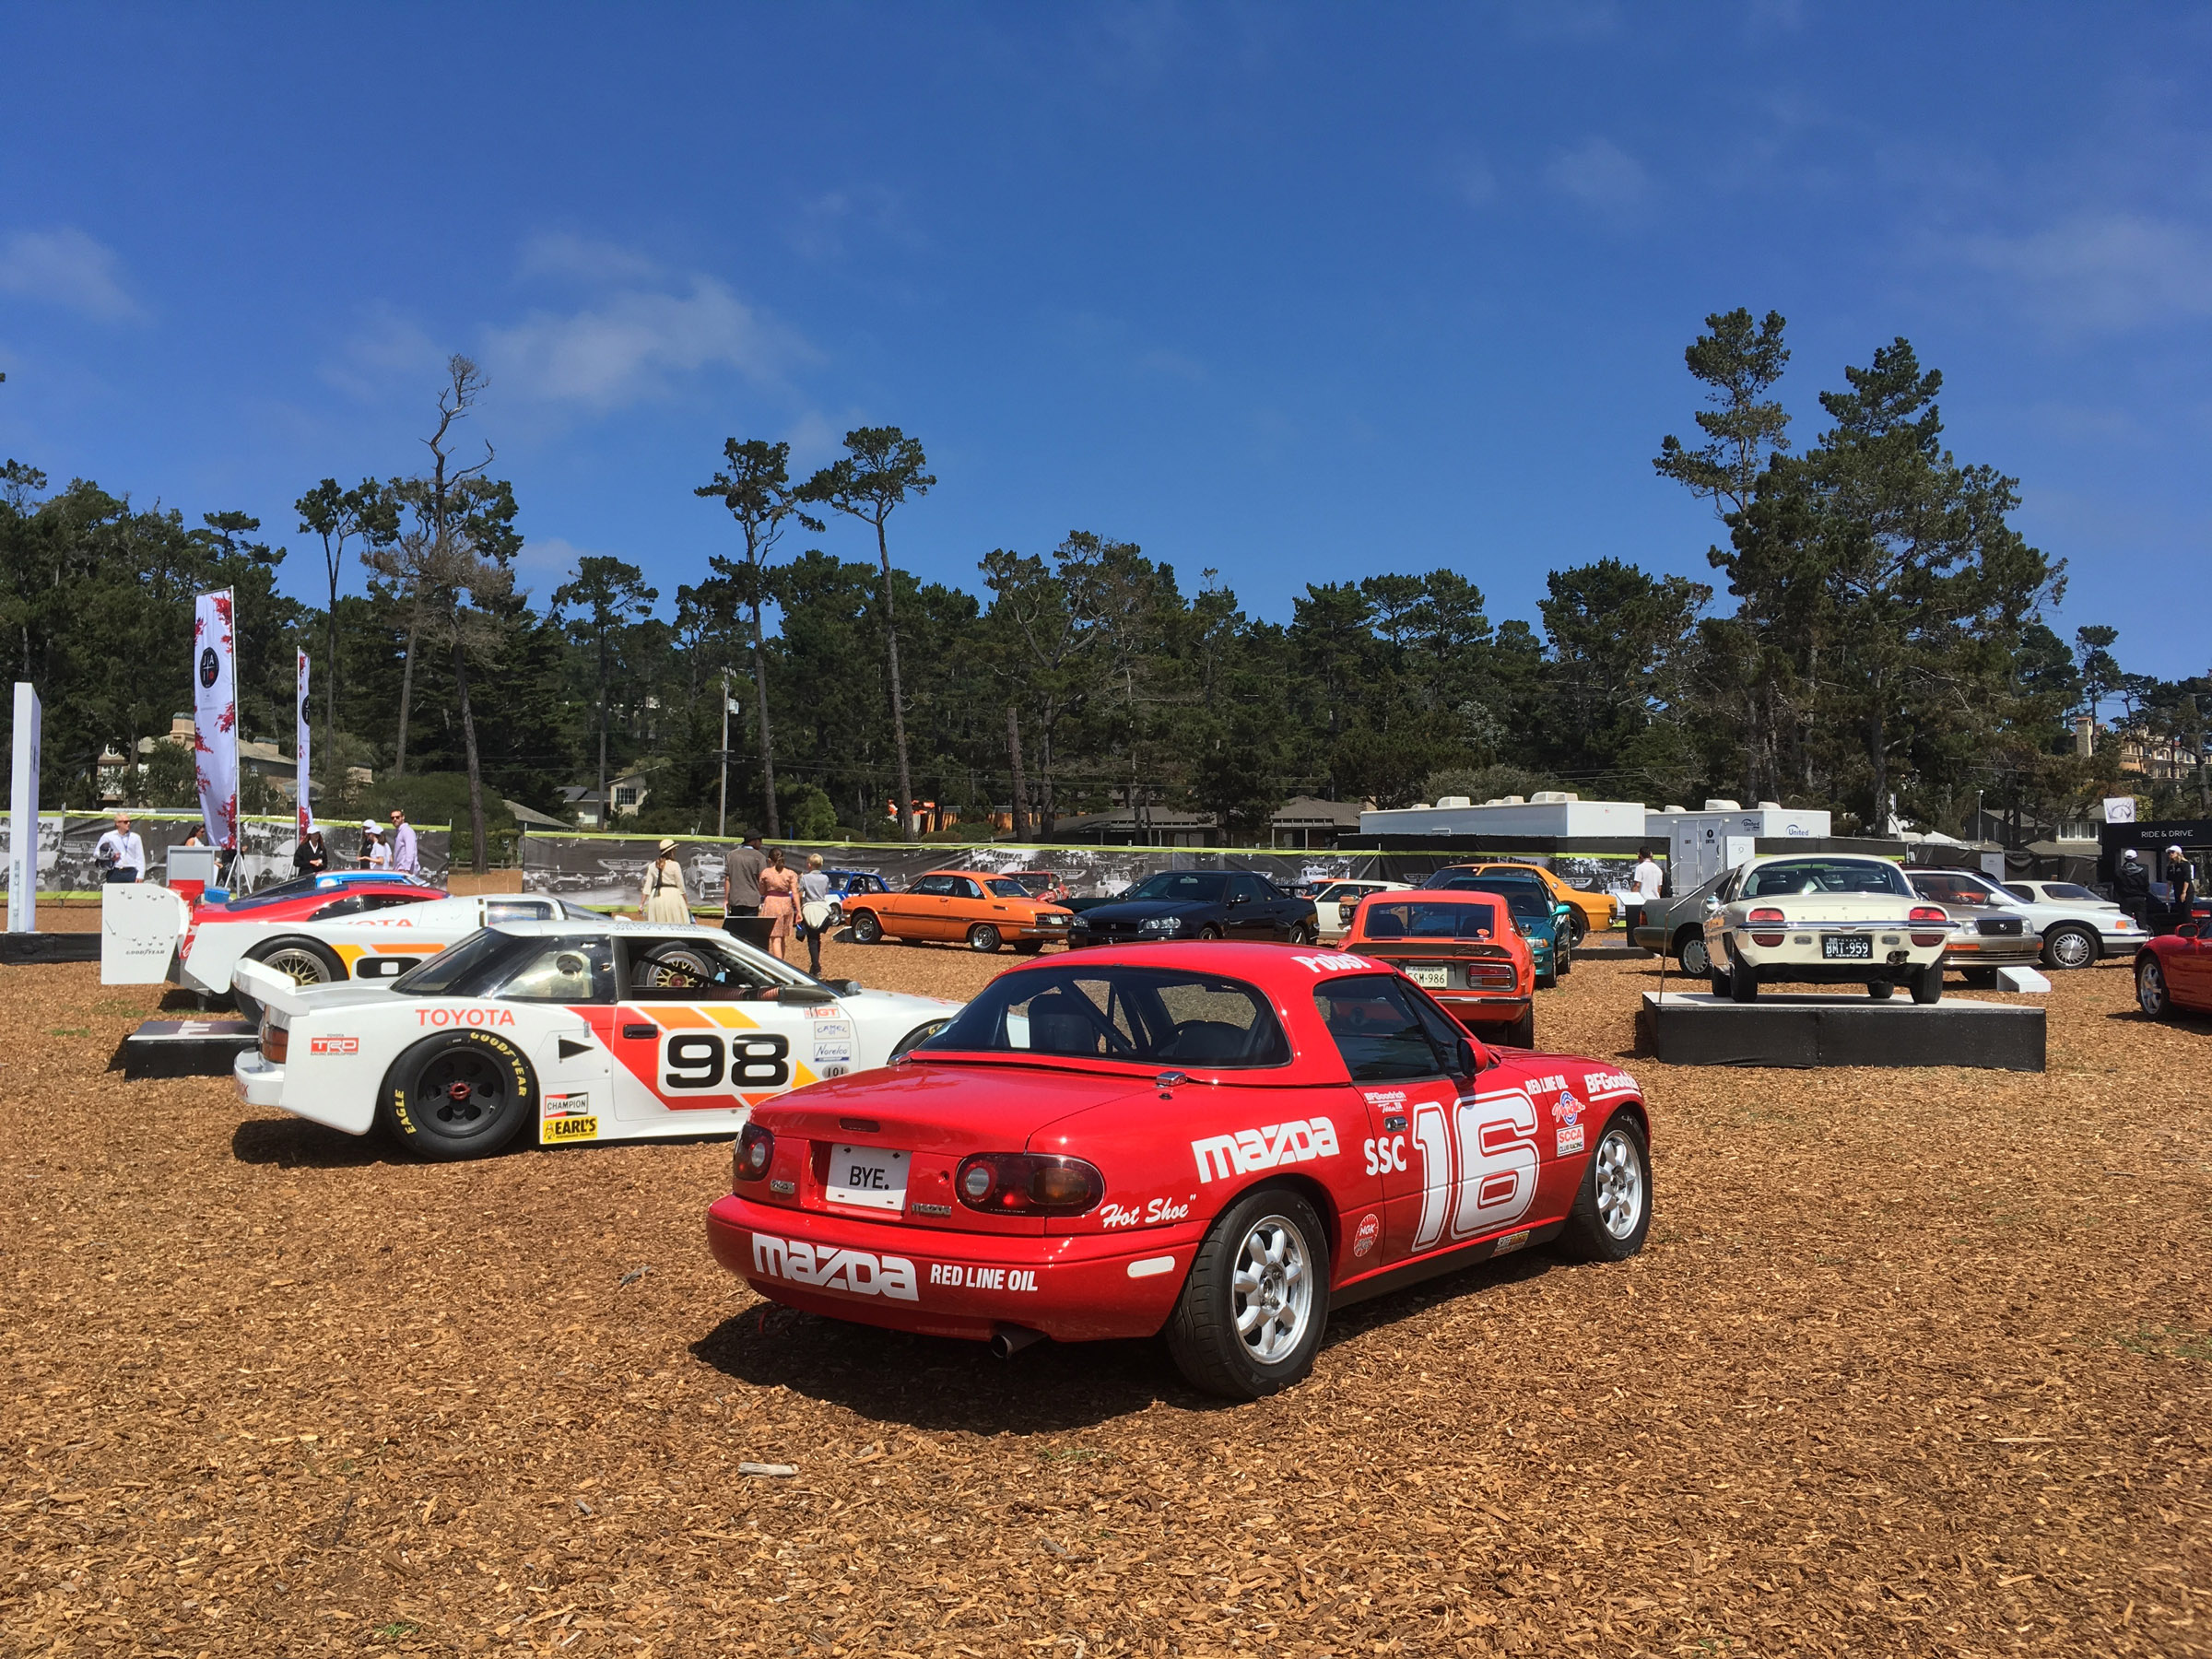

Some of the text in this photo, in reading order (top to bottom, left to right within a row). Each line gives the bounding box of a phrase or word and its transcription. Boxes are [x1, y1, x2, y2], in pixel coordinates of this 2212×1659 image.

[1788, 828, 1809, 836] United
[2169, 830, 2194, 838] DRIVE
[415, 1008, 515, 1026] TOYOTA
[817, 1024, 847, 1033] CAMEL
[312, 1040, 357, 1053] TRD
[816, 1043, 848, 1058] Norelco
[470, 1031, 528, 1097] GOODYEAR
[665, 1033, 789, 1088] 98
[1524, 1075, 1569, 1095] RED LINE OIL
[1363, 1090, 1406, 1100] BFGoodrich
[394, 1089, 417, 1135] EAGLE
[547, 1100, 586, 1111] CHAMPION
[555, 1118, 596, 1135] EARL'S
[1559, 1129, 1583, 1143] SCCA
[1570, 1141, 1583, 1149] RACING
[1364, 1135, 1407, 1176] SSC
[849, 1165, 889, 1190] BYE.
[1411, 1087, 1540, 1253] 16
[1100, 1204, 1140, 1229] Hot
[1359, 1223, 1376, 1236] NGK
[930, 1264, 1039, 1291] RED LINE OIL
